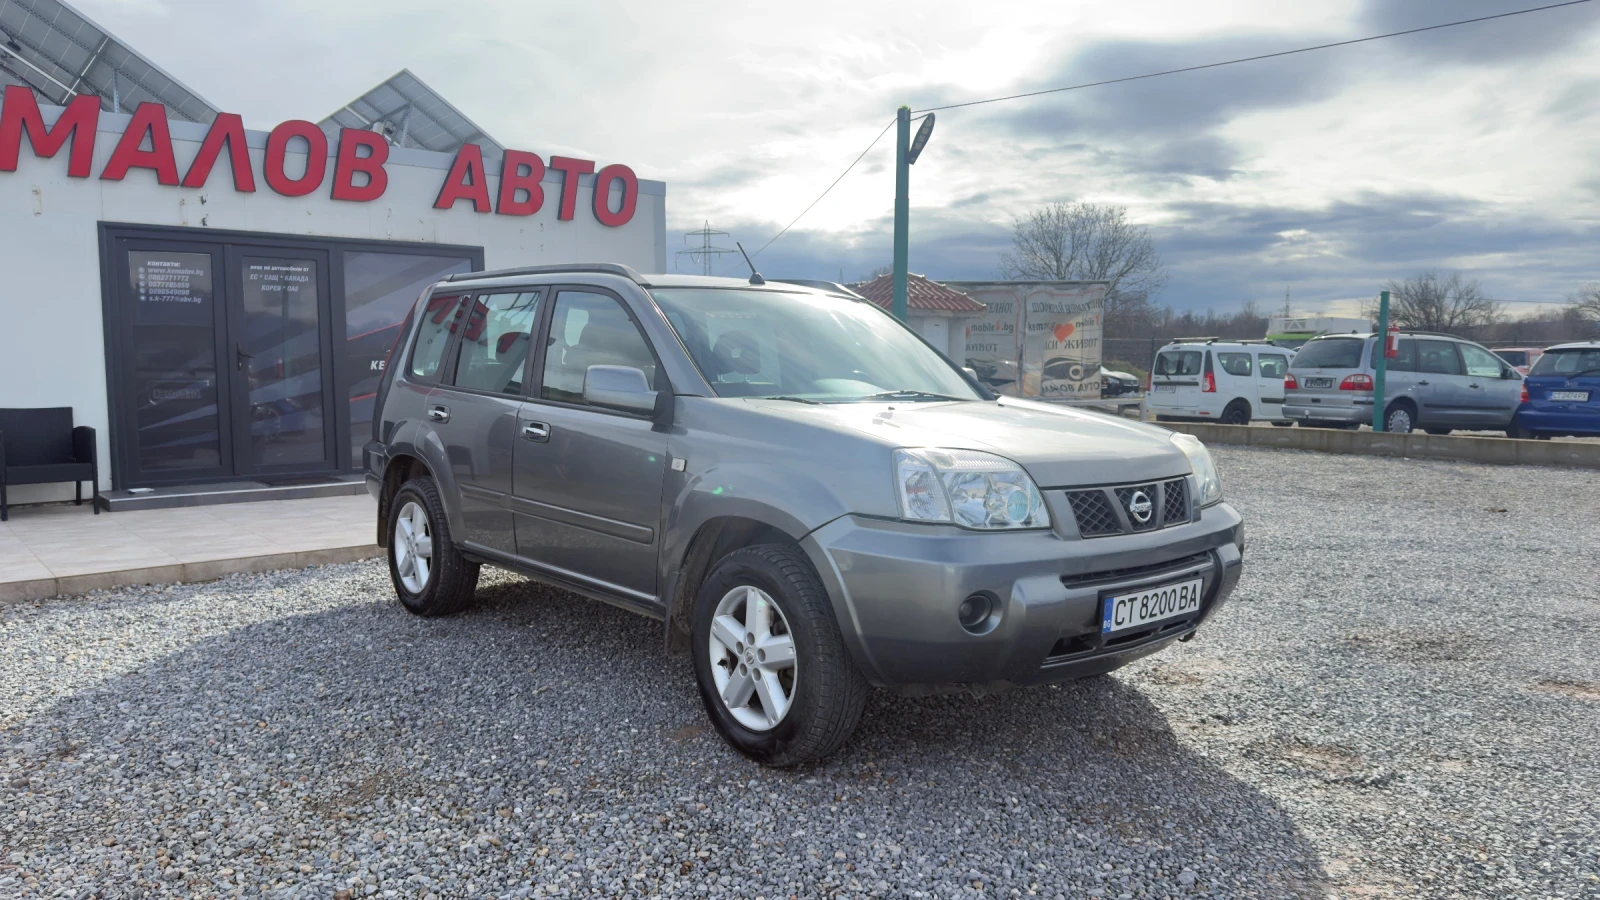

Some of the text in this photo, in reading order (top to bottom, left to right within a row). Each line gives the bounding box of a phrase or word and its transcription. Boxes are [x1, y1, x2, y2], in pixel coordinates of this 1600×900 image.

[434, 144, 639, 228] АВТО
[264, 274, 279, 282] САЩ
[284, 275, 309, 283] КАНАДА
[1064, 338, 1098, 350] ЖИВОТ
[1077, 381, 1100, 392] АУТО
[1115, 597, 1137, 625] CT
[1140, 589, 1177, 619] 8200
[1179, 584, 1197, 611] BA
